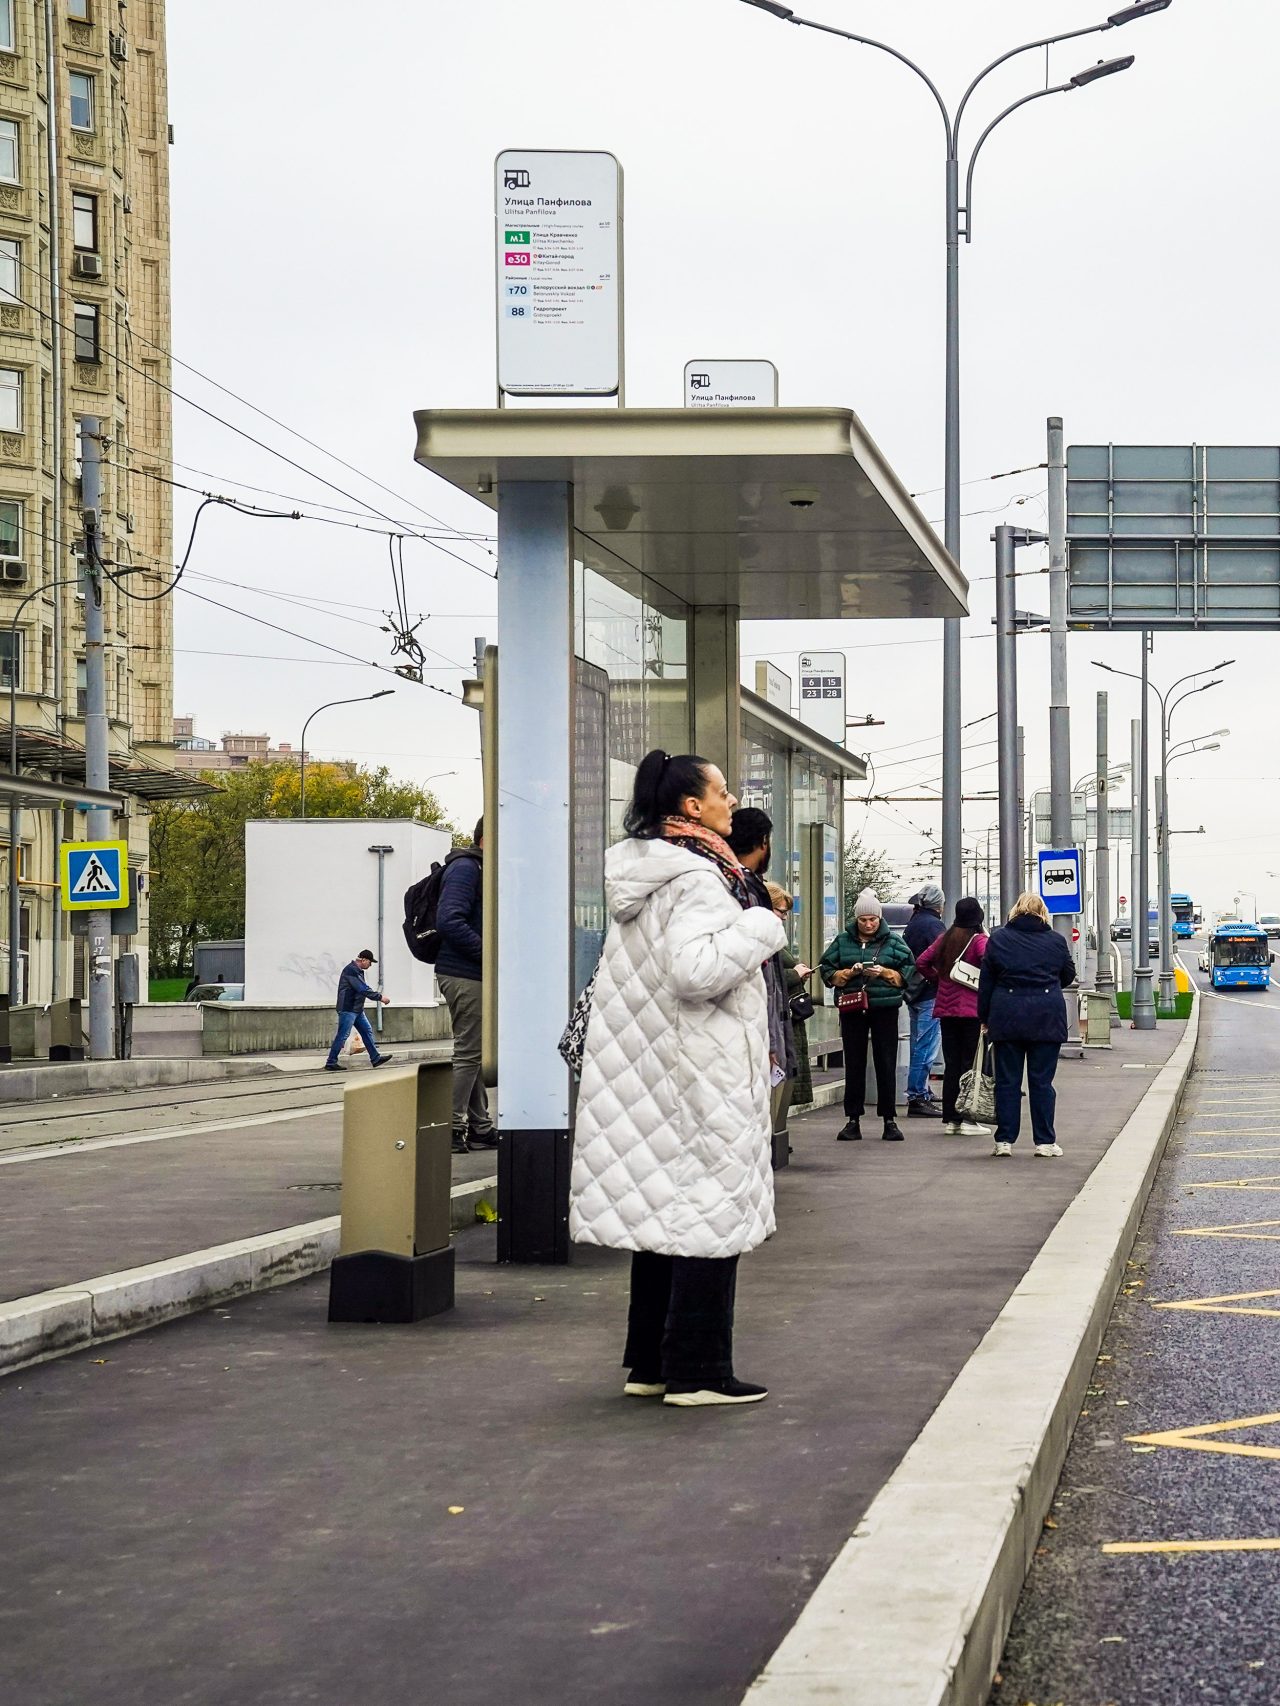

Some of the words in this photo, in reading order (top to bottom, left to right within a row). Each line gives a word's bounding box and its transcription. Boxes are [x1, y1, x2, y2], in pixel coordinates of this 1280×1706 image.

[505, 198, 534, 206] Улица
[537, 198, 592, 207] Панфилова
[512, 308, 525, 316] 88
[715, 394, 756, 402] Панфилова
[827, 678, 836, 686] 15
